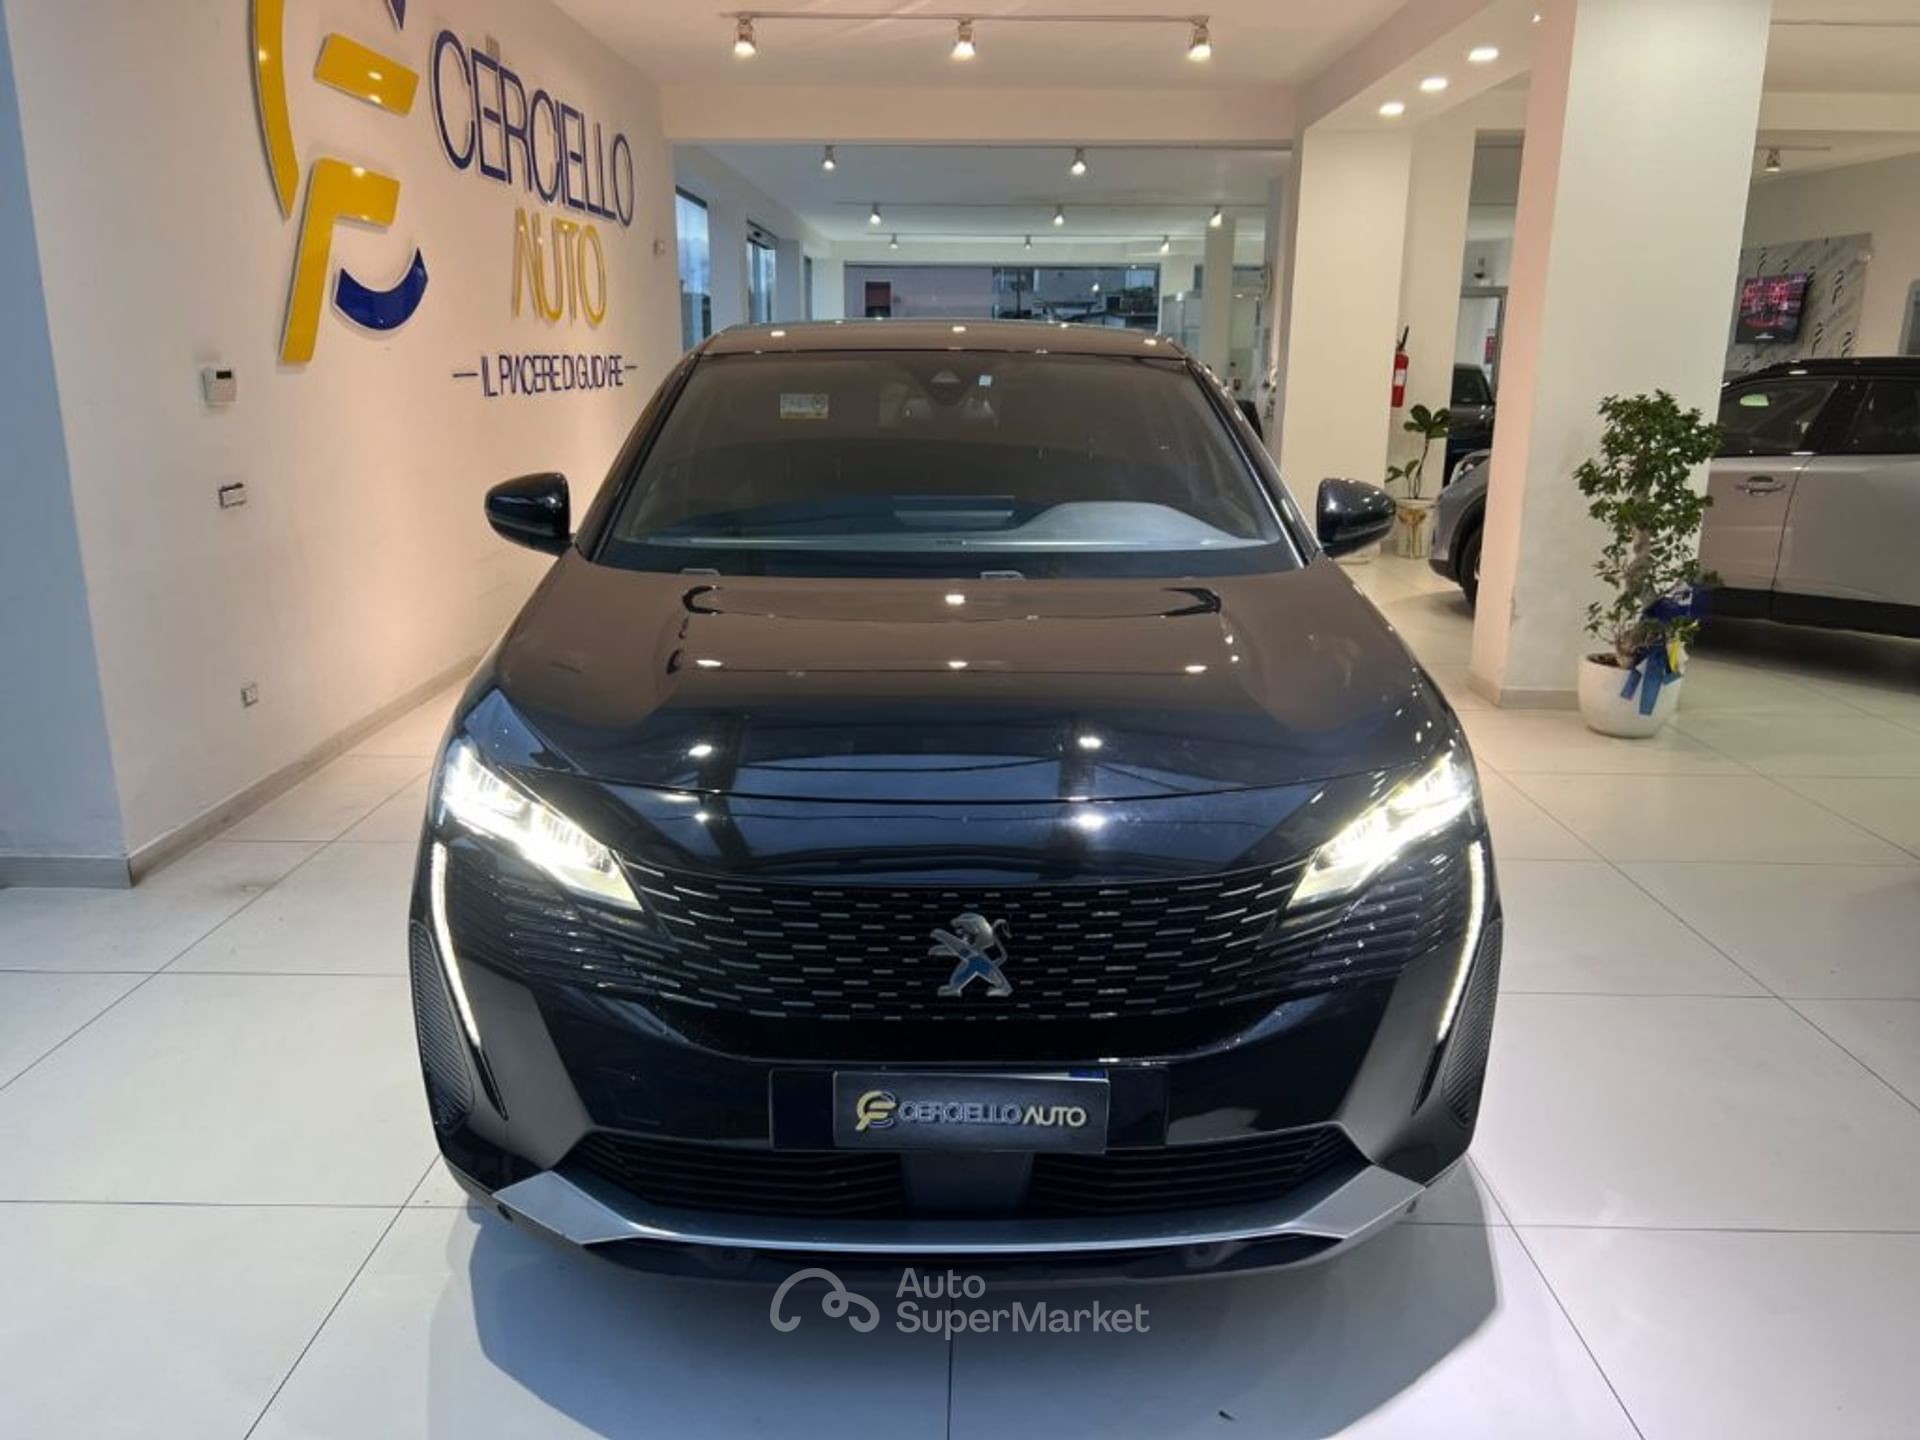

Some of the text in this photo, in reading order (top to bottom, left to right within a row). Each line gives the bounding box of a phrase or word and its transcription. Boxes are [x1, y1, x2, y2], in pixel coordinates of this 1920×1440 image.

[433, 29, 635, 228] CERCIELLO
[511, 207, 607, 328] AUTO
[899, 1101, 1088, 1128] CERCIELLO AUTO
